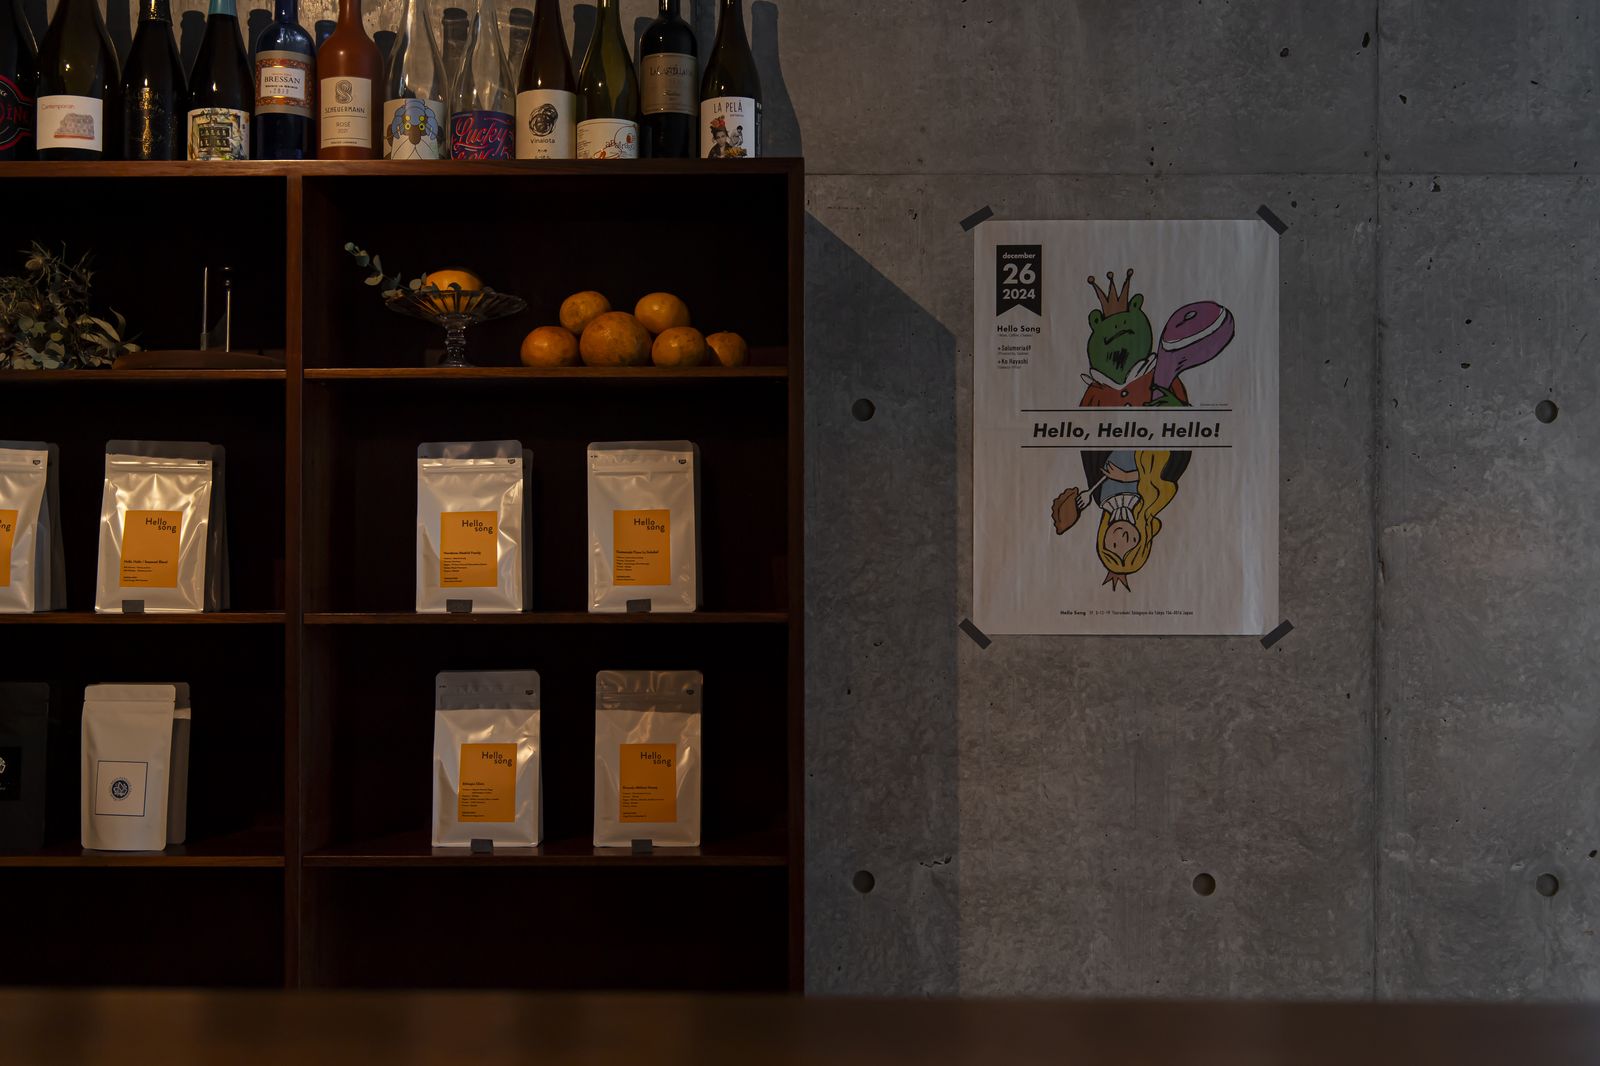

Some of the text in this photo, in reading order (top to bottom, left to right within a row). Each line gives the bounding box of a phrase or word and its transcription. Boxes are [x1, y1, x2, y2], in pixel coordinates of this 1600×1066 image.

[264, 76, 301, 84] BRESSAN
[713, 102, 723, 113] LA
[455, 117, 509, 156] Lucky
[1002, 263, 1036, 285] 26
[1002, 288, 1036, 300] 2024
[997, 325, 1041, 334] Hello Song
[1033, 421, 1220, 441] Hello, Hello, Hello!
[145, 517, 168, 526] Hello
[462, 519, 484, 527] Hello
[633, 517, 656, 526] Hello
[158, 525, 177, 534] song
[474, 526, 494, 534] song
[646, 524, 666, 533] song
[481, 751, 503, 759] Hello
[640, 751, 662, 759] Hello
[494, 758, 513, 767] song
[653, 758, 672, 767] song
